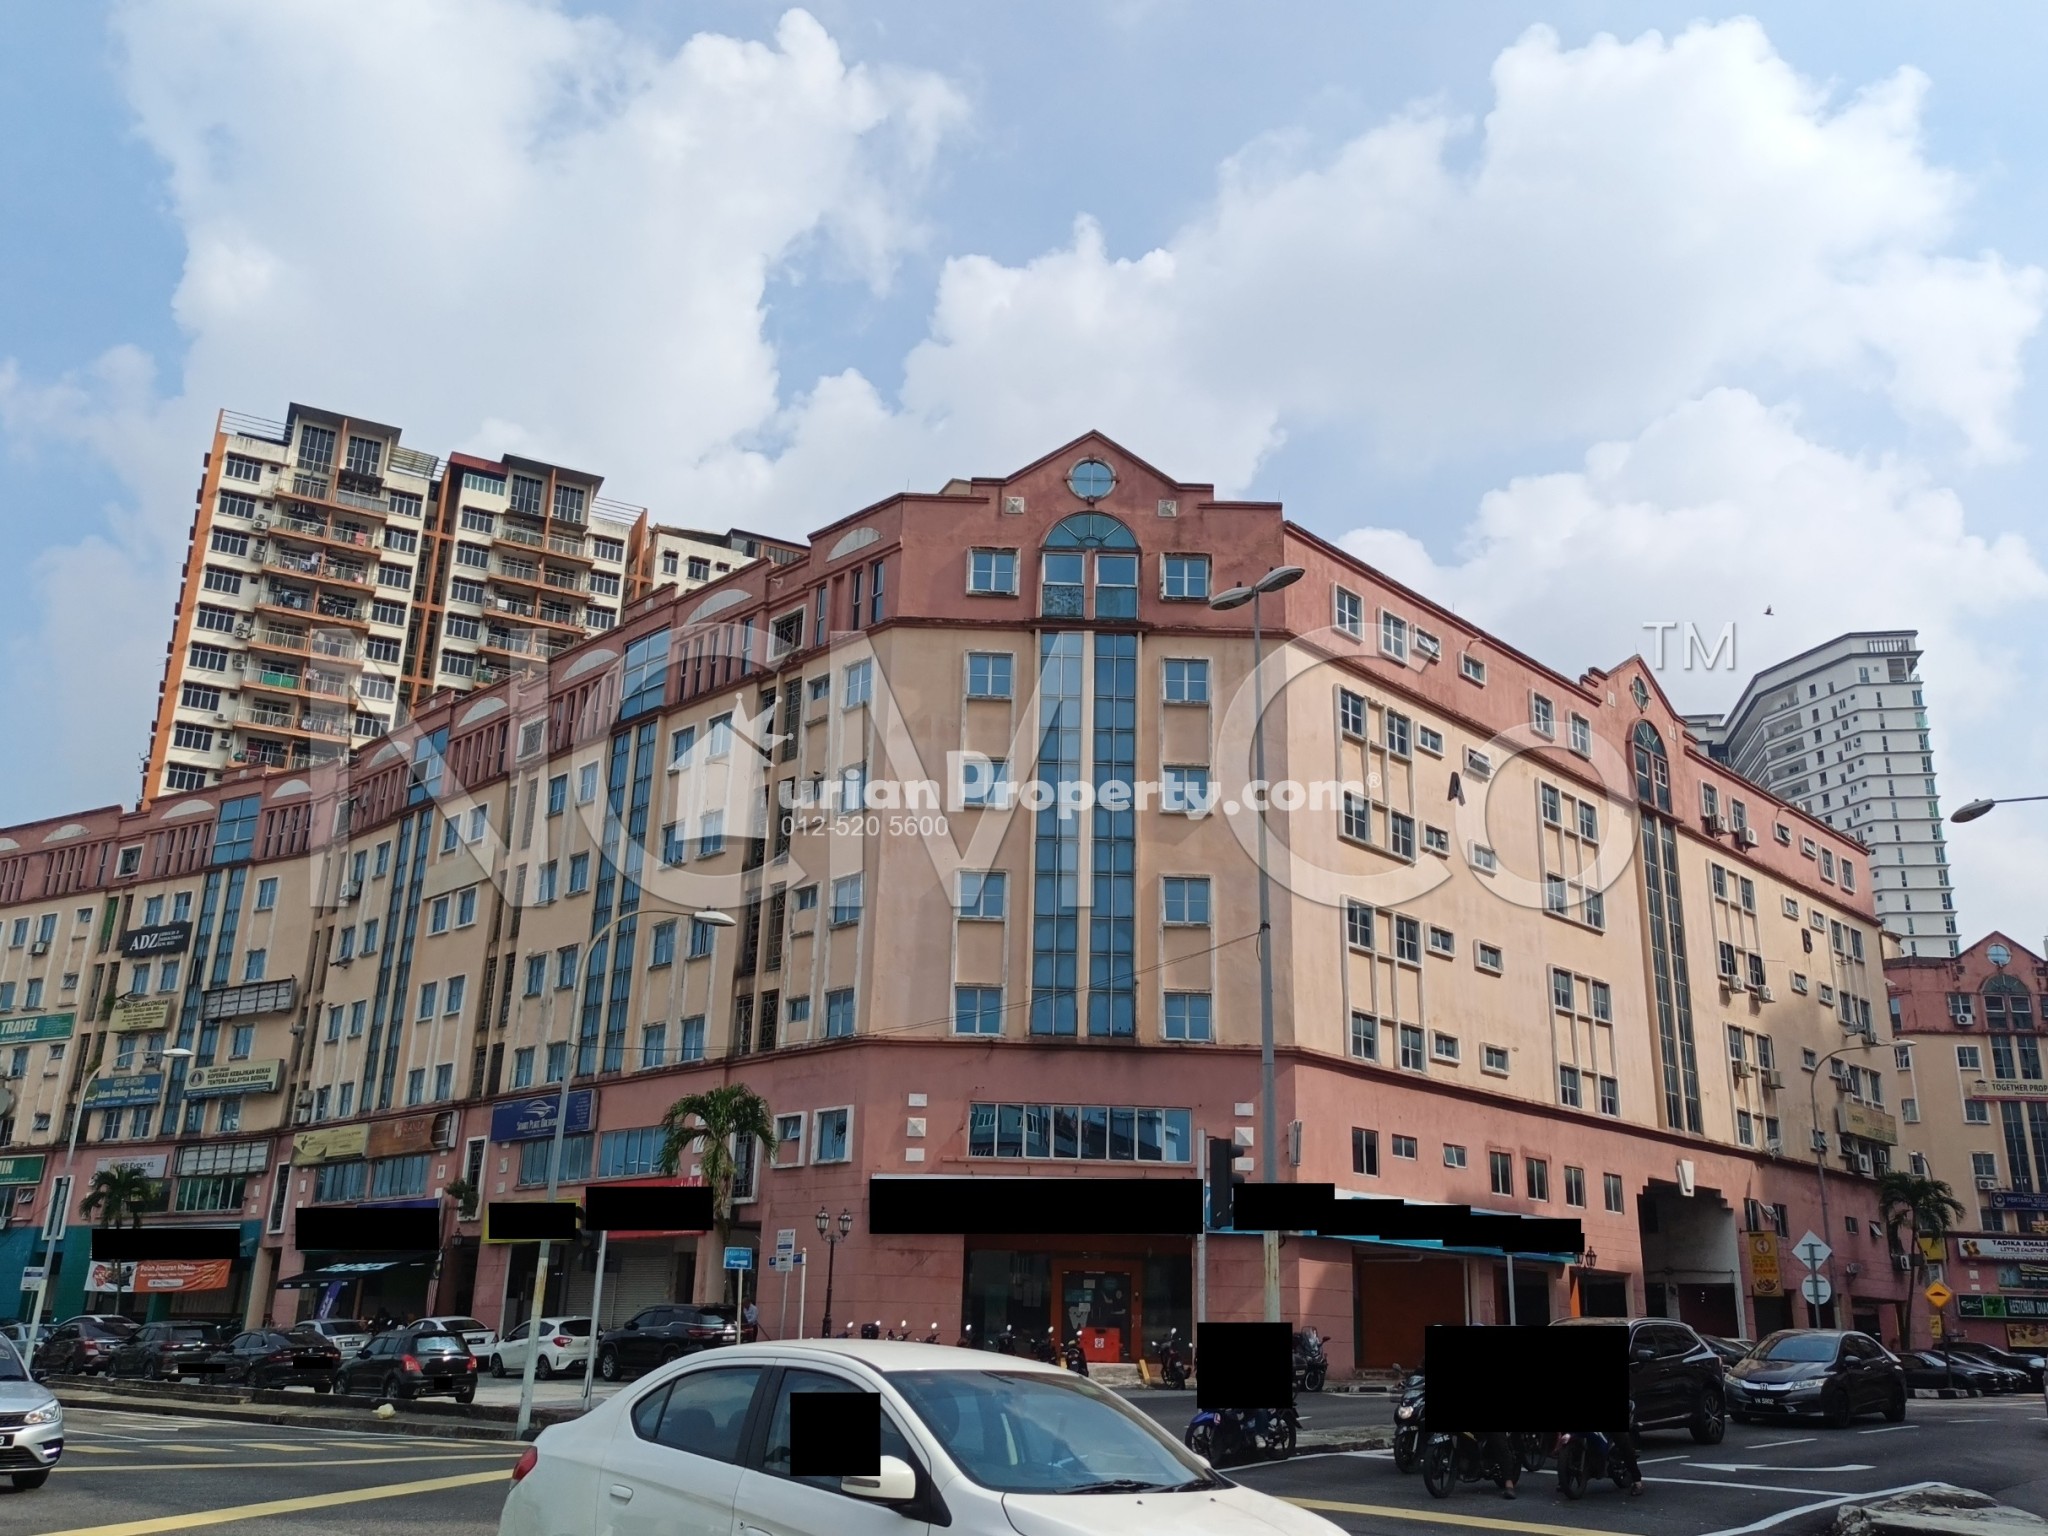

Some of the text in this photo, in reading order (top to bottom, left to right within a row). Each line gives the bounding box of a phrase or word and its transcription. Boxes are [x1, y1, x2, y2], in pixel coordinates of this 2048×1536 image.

[129, 933, 159, 951] ADZ
[0, 1018, 38, 1035] TRAVEL
[208, 1071, 229, 1079] KOPERASI
[230, 1069, 255, 1077] KEBAJIKAN
[228, 1076, 249, 1084] MALAYSIA
[1992, 1083, 2028, 1092] TOGETHER
